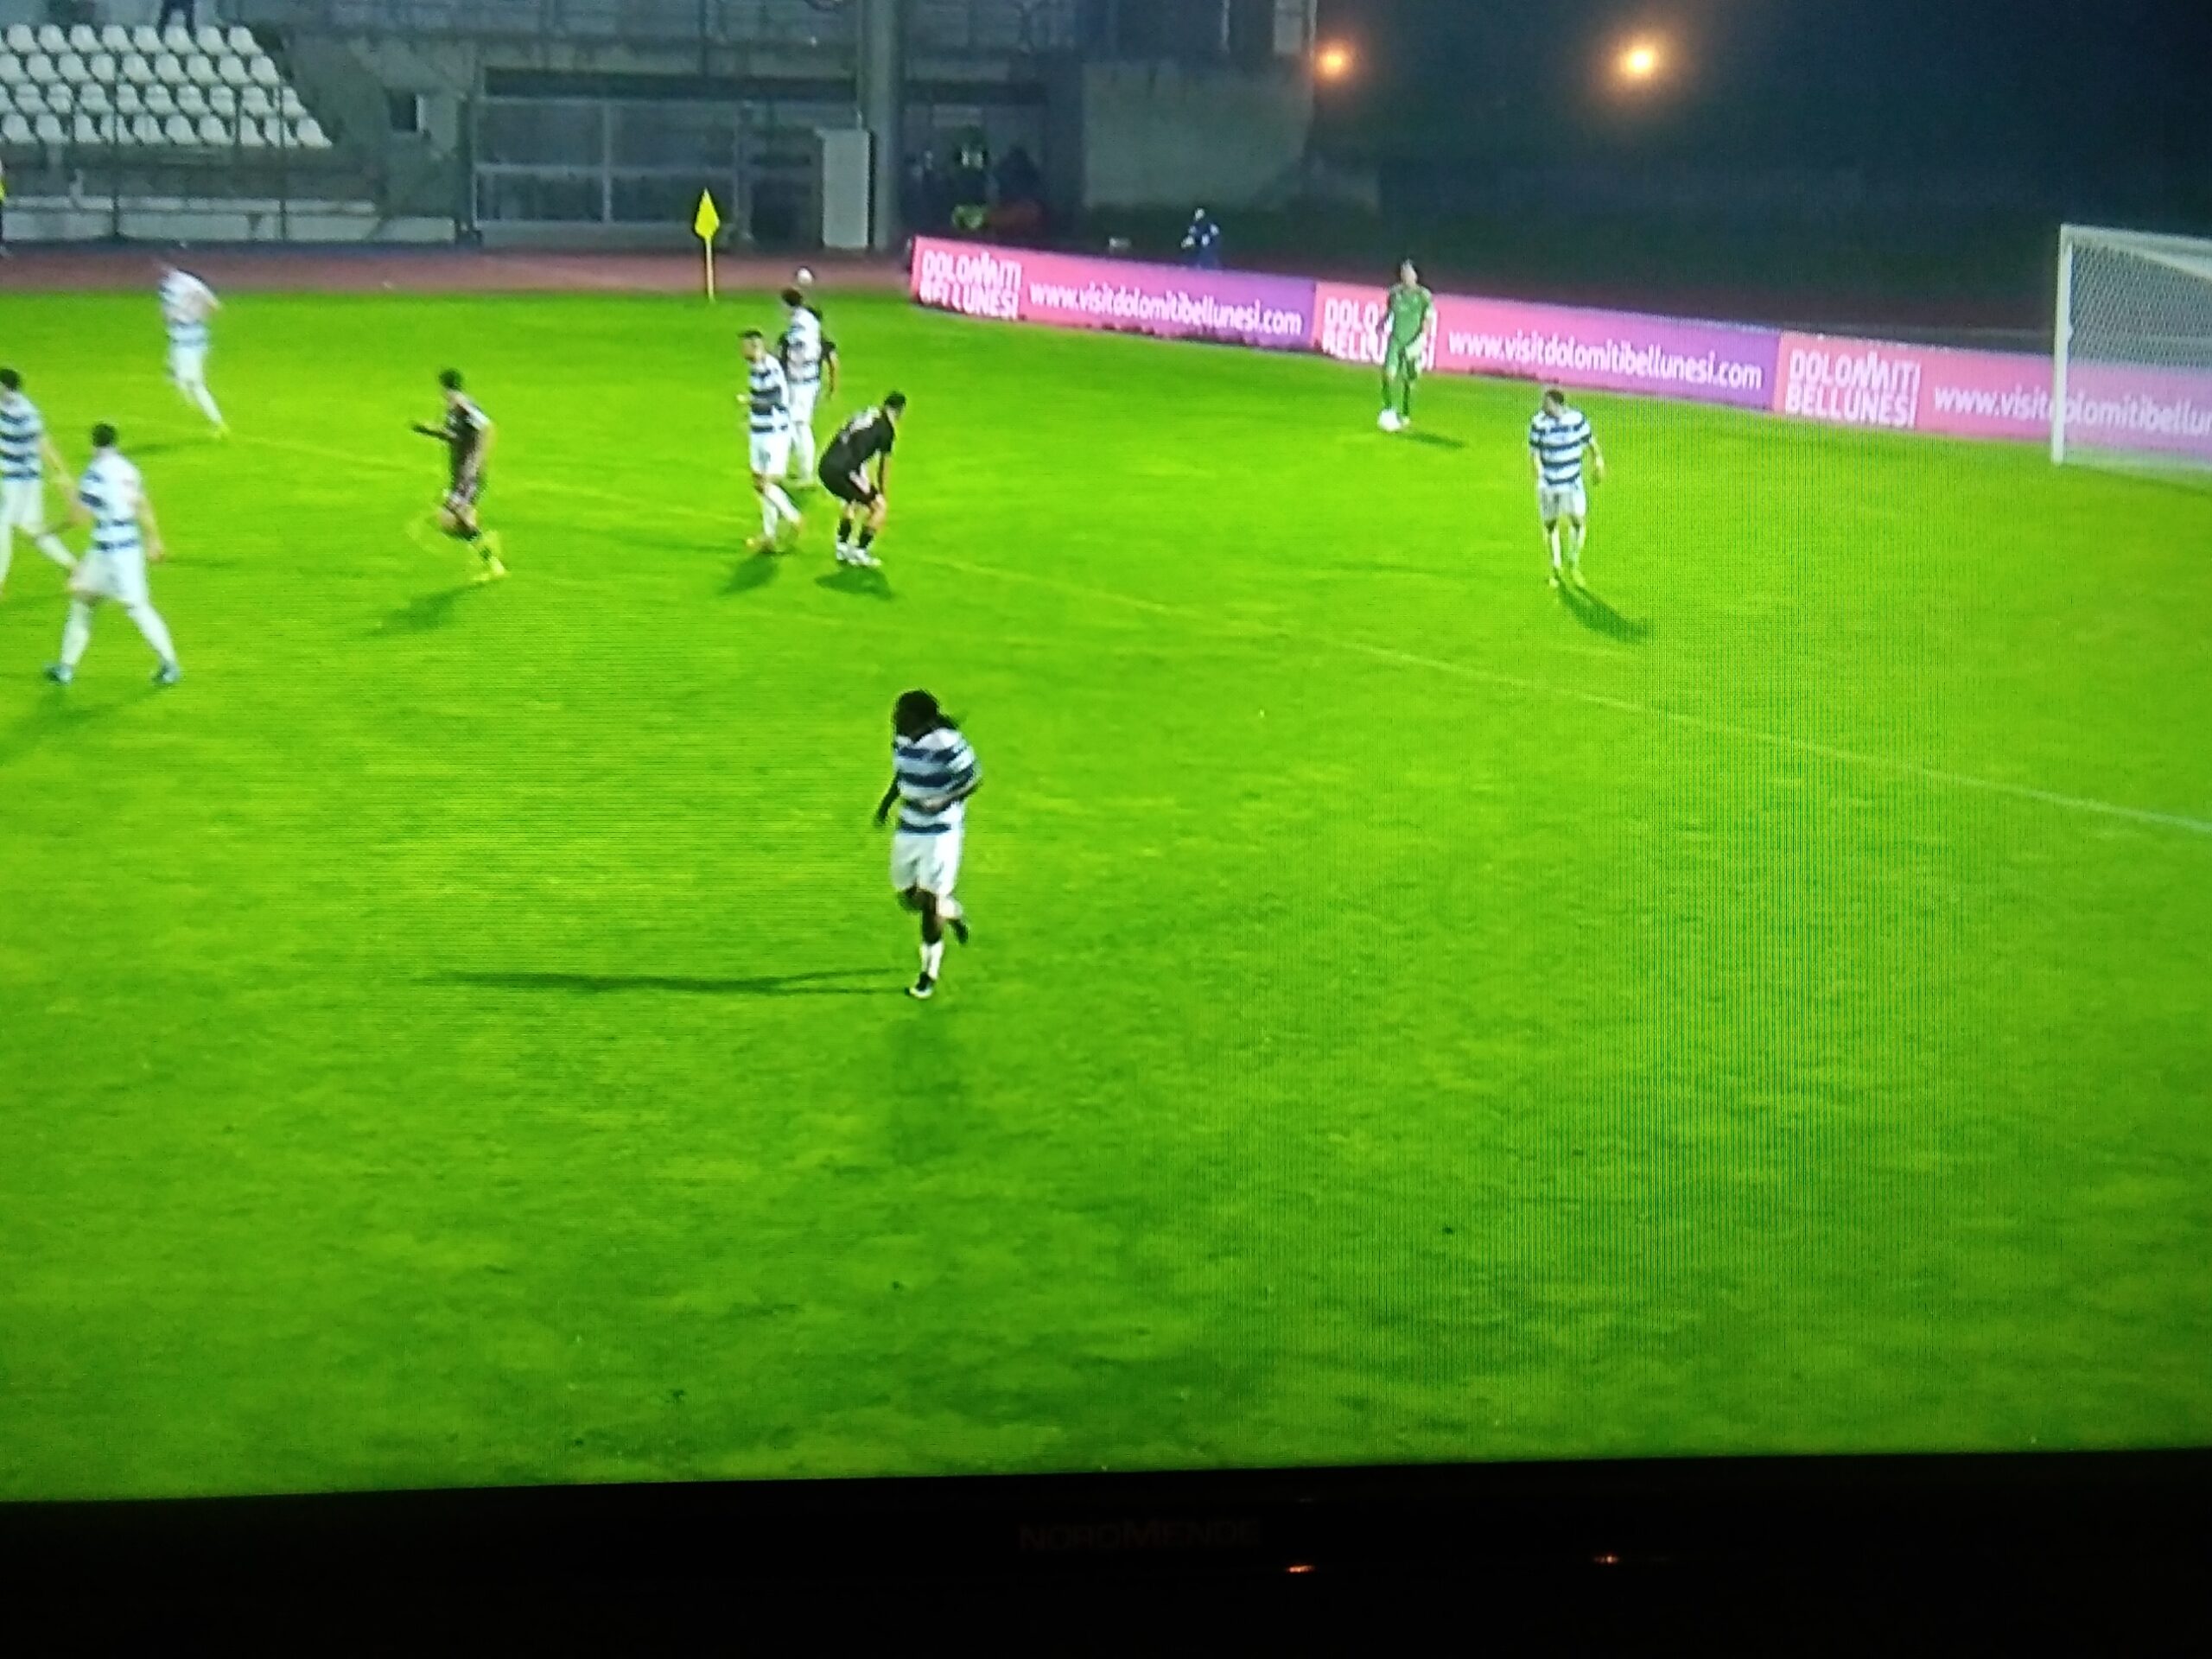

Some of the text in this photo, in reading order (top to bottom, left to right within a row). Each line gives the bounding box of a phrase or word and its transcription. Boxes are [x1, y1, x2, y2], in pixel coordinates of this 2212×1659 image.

[1028, 282, 1302, 335] www.visitdolomitibellunesi.com
[1448, 329, 1763, 390] www.visitdolomitibellunesi.com
[1790, 349, 1921, 392] DOLOMITI
[1785, 382, 1917, 429] BELLUNESI
